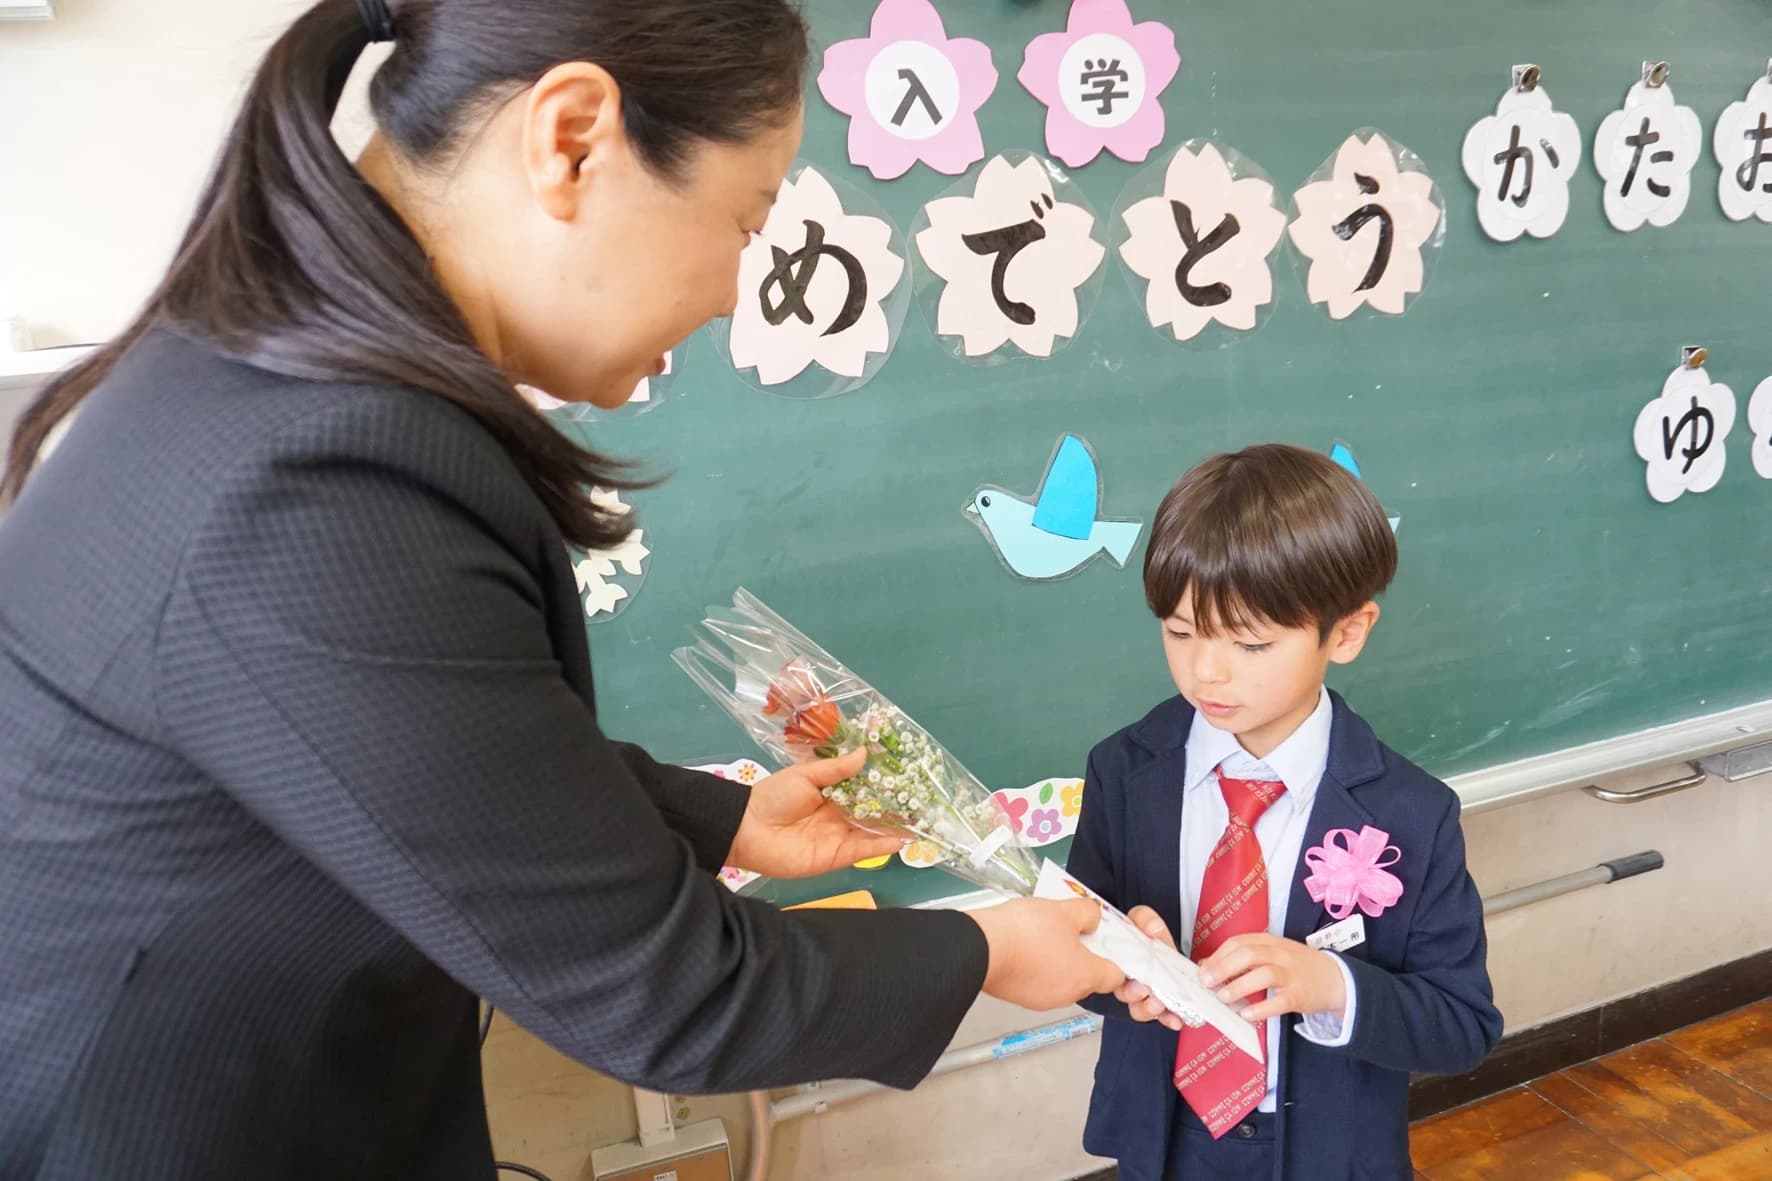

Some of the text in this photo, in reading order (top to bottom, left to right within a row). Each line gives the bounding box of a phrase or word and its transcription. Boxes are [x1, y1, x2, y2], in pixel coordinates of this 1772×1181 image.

[892, 59, 1128, 125] 入学
[759, 173, 1393, 336] めでとう
[1663, 396, 1714, 474] ゆ
